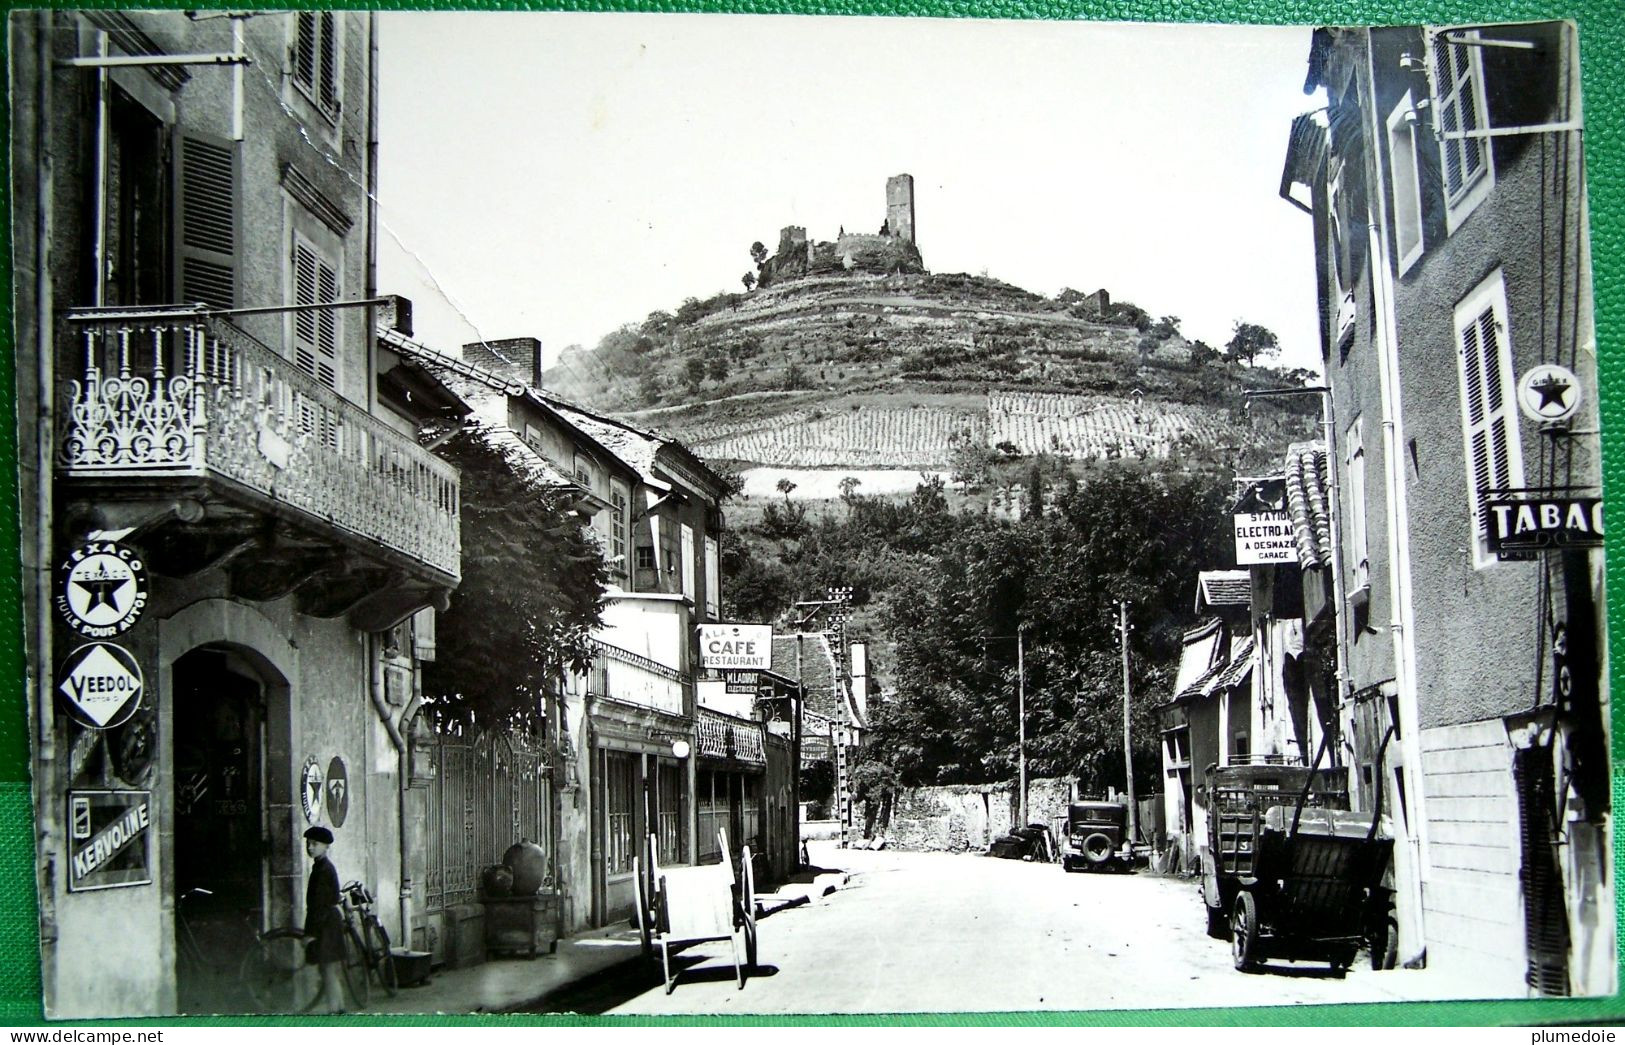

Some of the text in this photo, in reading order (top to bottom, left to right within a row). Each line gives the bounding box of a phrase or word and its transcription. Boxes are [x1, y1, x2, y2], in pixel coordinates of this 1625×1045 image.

[61, 543, 142, 571] TEXACO
[1245, 542, 1251, 550] A
[1258, 551, 1289, 559] GARAGE
[56, 591, 148, 638] HUILE POUR AUTOS
[703, 655, 764, 666] RESTAURANT
[70, 674, 134, 703] VEEDOL
[73, 803, 149, 879] KERVOLINE
